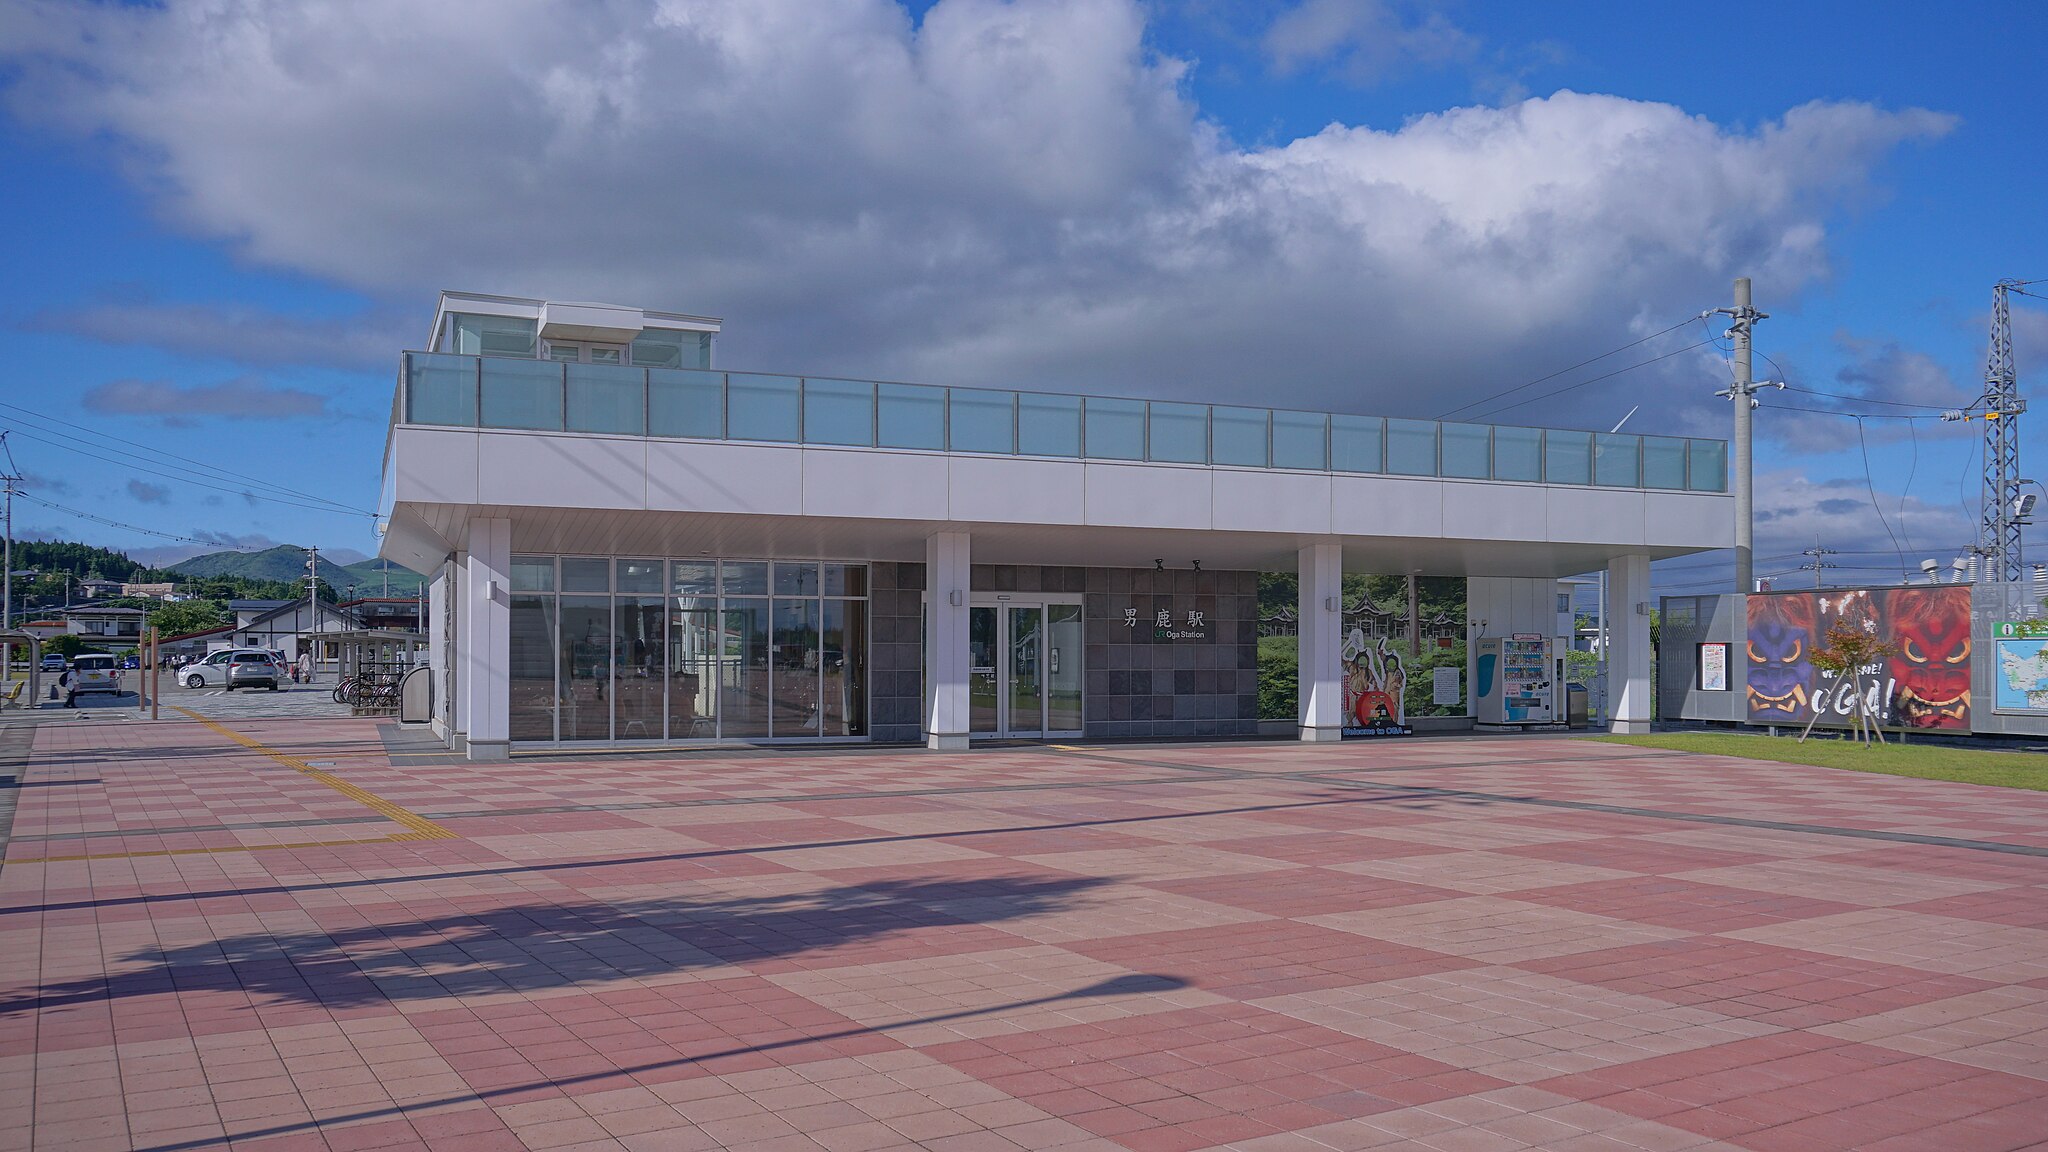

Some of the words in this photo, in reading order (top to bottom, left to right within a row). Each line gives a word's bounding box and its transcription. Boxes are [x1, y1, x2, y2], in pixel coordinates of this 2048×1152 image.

[1123, 608, 1205, 628] 男鹿駅
[1154, 630, 1166, 638] JR
[1166, 630, 1180, 640] Oga
[1180, 630, 1205, 639] Station
[1811, 678, 1896, 720] OGA!
[1386, 727, 1403, 735] OGA
